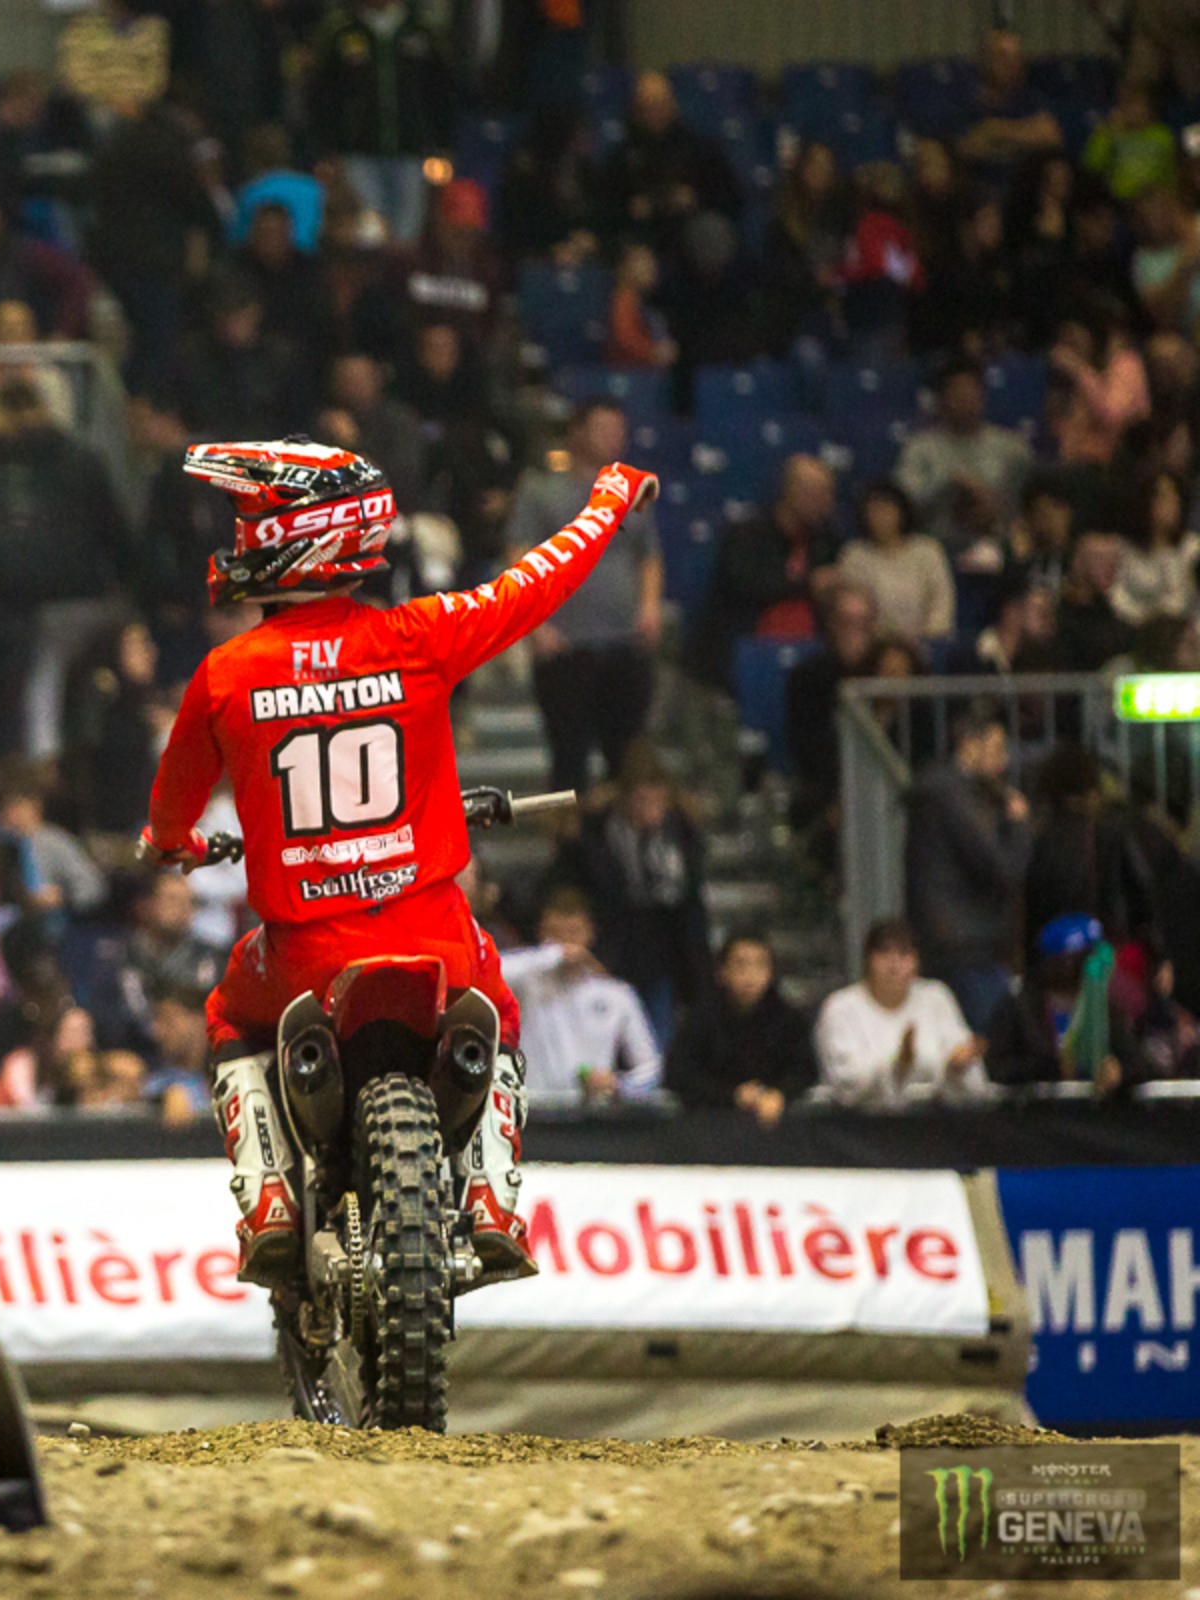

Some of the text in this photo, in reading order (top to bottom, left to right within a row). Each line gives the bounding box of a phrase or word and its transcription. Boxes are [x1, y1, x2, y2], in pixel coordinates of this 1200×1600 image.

[290, 636, 343, 671] FLY
[252, 671, 404, 721] BRAYTON
[272, 718, 404, 837] 10
